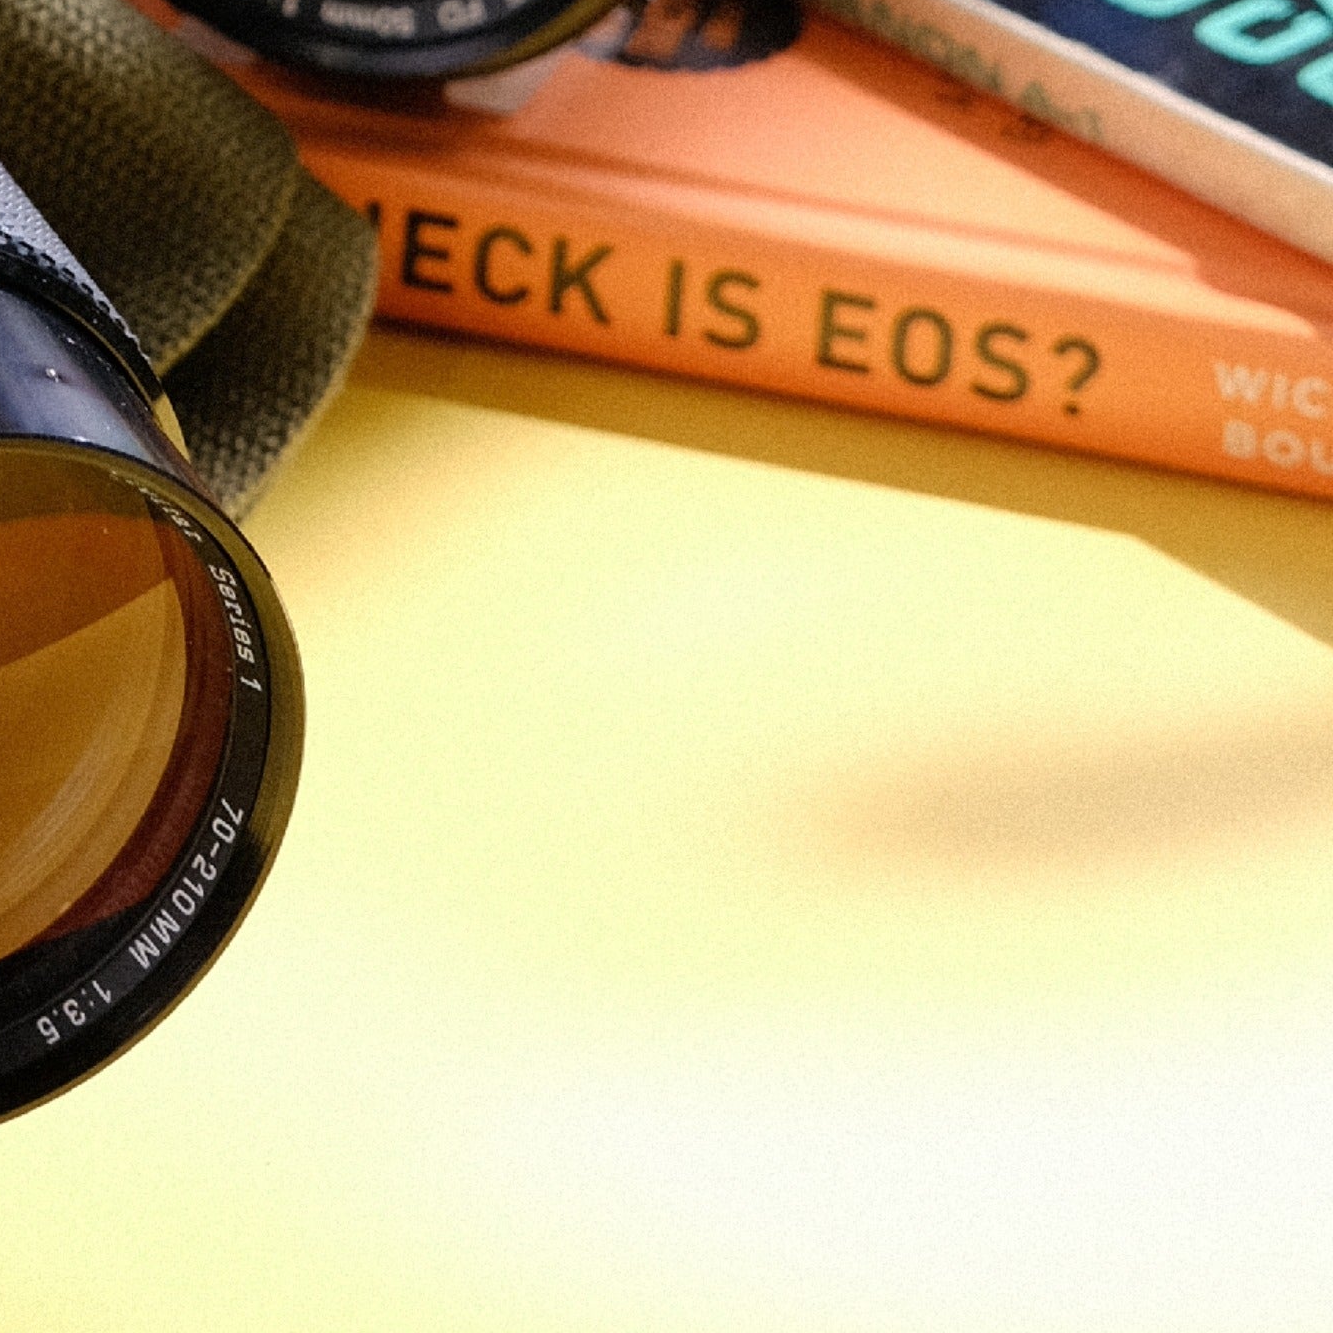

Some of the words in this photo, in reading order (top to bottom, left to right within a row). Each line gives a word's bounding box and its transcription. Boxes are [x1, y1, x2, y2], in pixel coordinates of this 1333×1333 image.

[367, 200, 615, 326] ECK
[663, 255, 763, 352] IS
[814, 285, 1102, 418] EOS?
[209, 564, 256, 664] Series
[241, 677, 262, 694] 1
